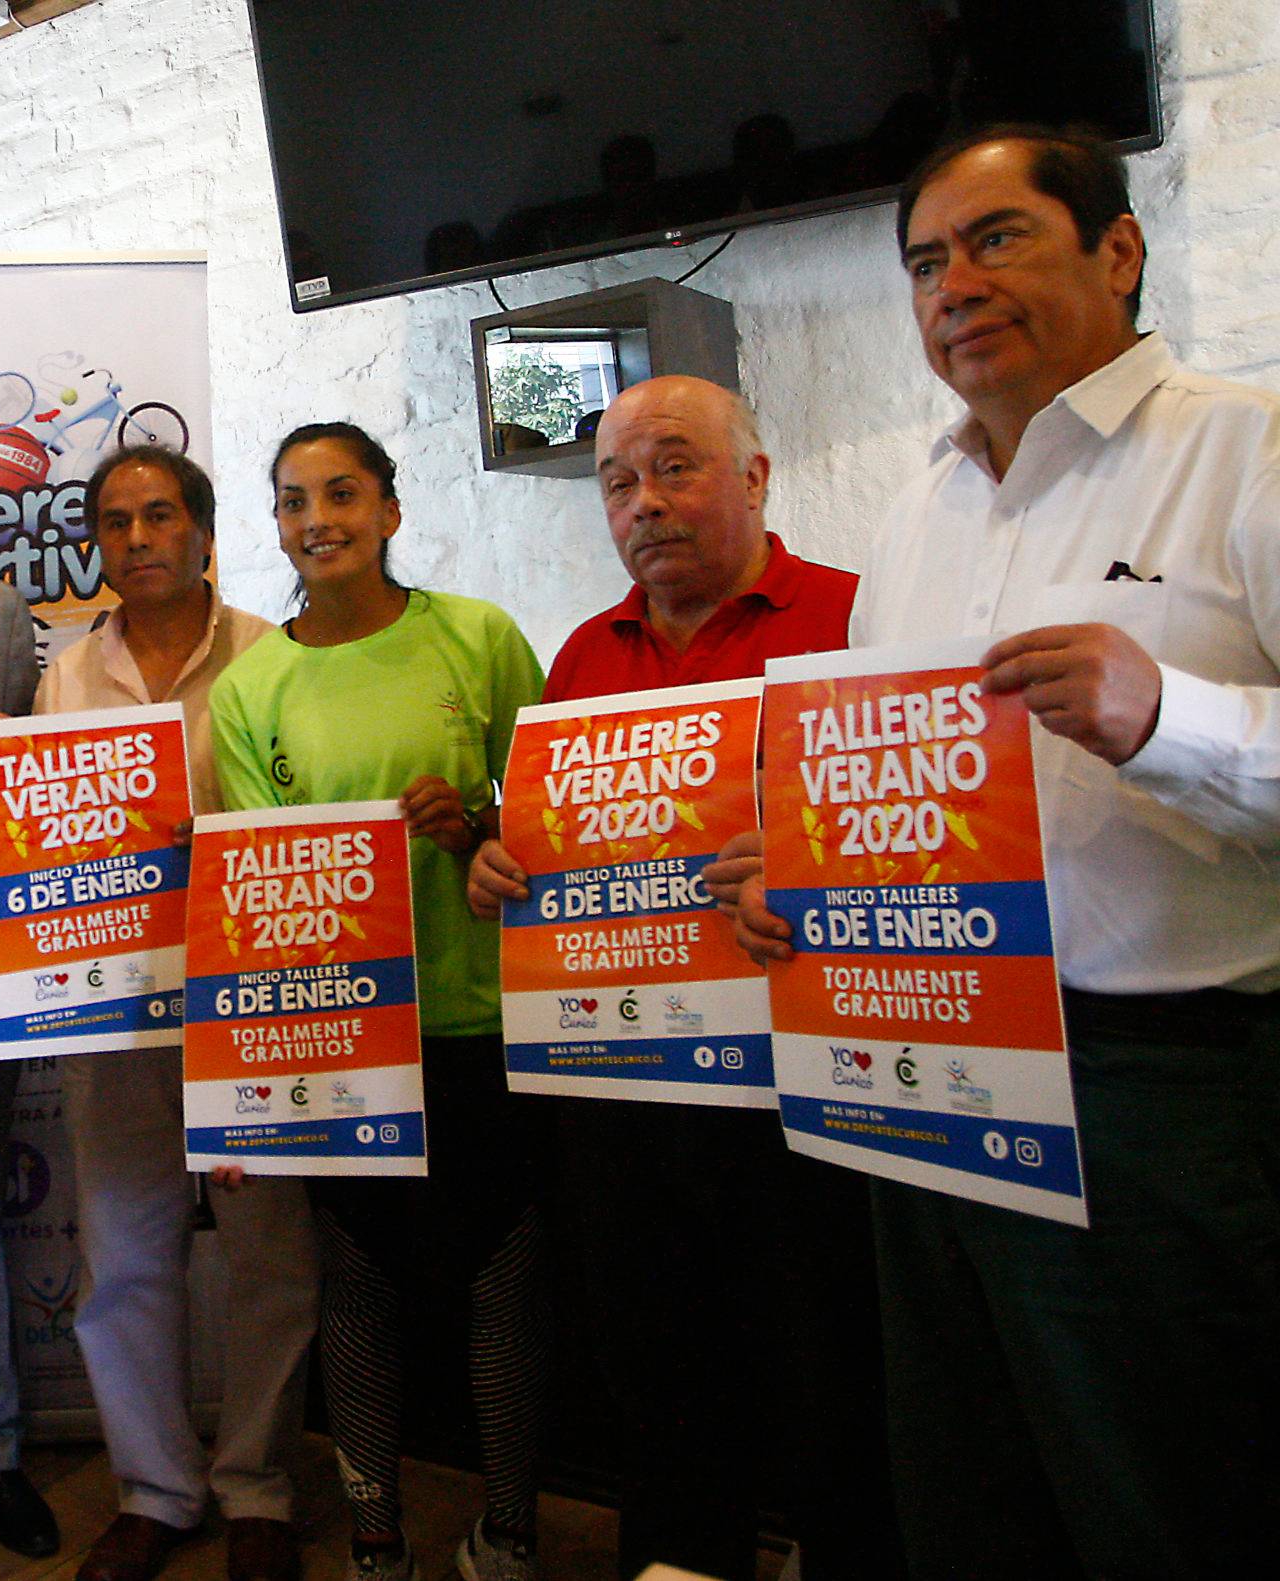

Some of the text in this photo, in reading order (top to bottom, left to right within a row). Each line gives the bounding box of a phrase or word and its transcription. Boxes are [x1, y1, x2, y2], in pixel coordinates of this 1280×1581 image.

[799, 682, 987, 756] TALLERES
[548, 711, 722, 772] TALLERES
[544, 750, 716, 808] VERANO
[800, 740, 987, 806] VERANO
[1, 767, 157, 820] VERANO
[39, 806, 127, 850] 2020
[577, 795, 676, 845] 2020
[838, 801, 946, 856] 2020
[29, 855, 137, 884] INICIO TALLERES
[222, 830, 375, 883] TALLERES
[565, 859, 686, 885] INICIO TALLERES
[7, 864, 162, 913] 6 DE ENERO
[222, 869, 375, 916] VERANO
[540, 889, 559, 920] 6
[565, 884, 603, 918] DE
[826, 887, 959, 905] INICIO TALLERES
[26, 904, 151, 939] TOTALMENTE
[36, 923, 144, 954] GRATUITOS
[253, 908, 340, 950] 2020
[555, 922, 701, 952] TOTALMENTE
[803, 907, 996, 948] 6 DE ENERO
[239, 965, 350, 986] INICIO TALLERES
[564, 945, 690, 972] GRATUITOS
[34, 975, 54, 987] YO
[215, 976, 377, 1016] 6 DE ENERO
[823, 966, 982, 996] TOTALMENTE
[559, 998, 581, 1012] YO
[833, 992, 971, 1024] GRATUITOS
[231, 1018, 363, 1046] TOTALMENTE
[240, 1039, 354, 1064] GRATUITOS
[830, 1046, 854, 1067] YO
[236, 1086, 255, 1099] YO
